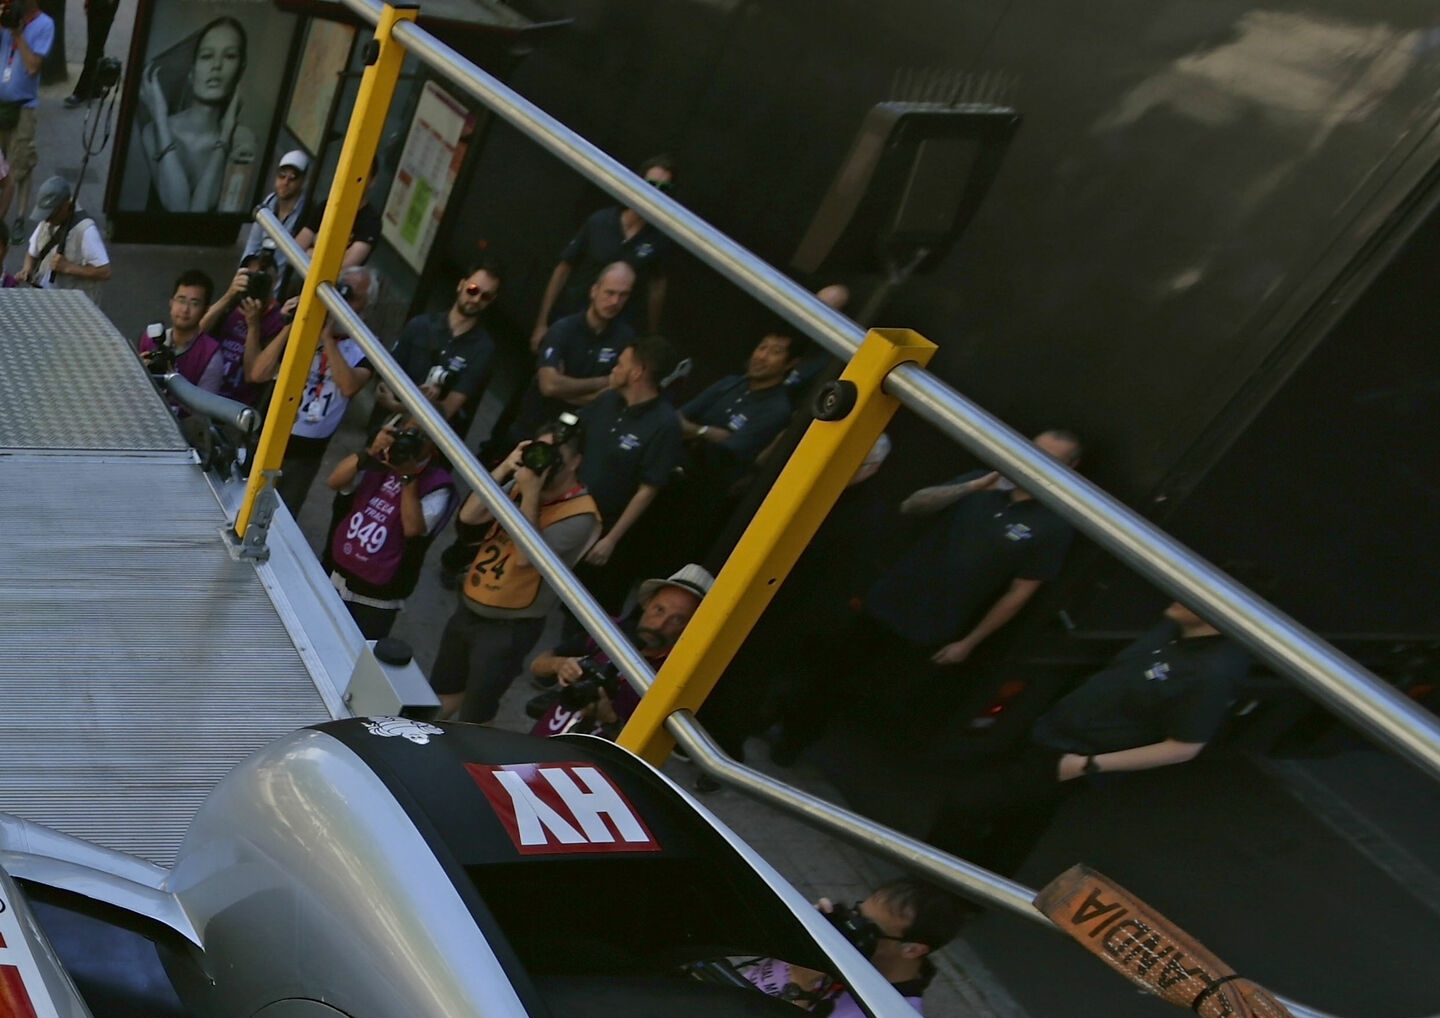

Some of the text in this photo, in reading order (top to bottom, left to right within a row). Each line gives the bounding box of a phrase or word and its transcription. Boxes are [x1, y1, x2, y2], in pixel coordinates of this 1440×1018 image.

[368, 496, 396, 515] MEDIA
[346, 511, 388, 554] 949
[475, 545, 512, 581] 24
[491, 766, 651, 846] HY
